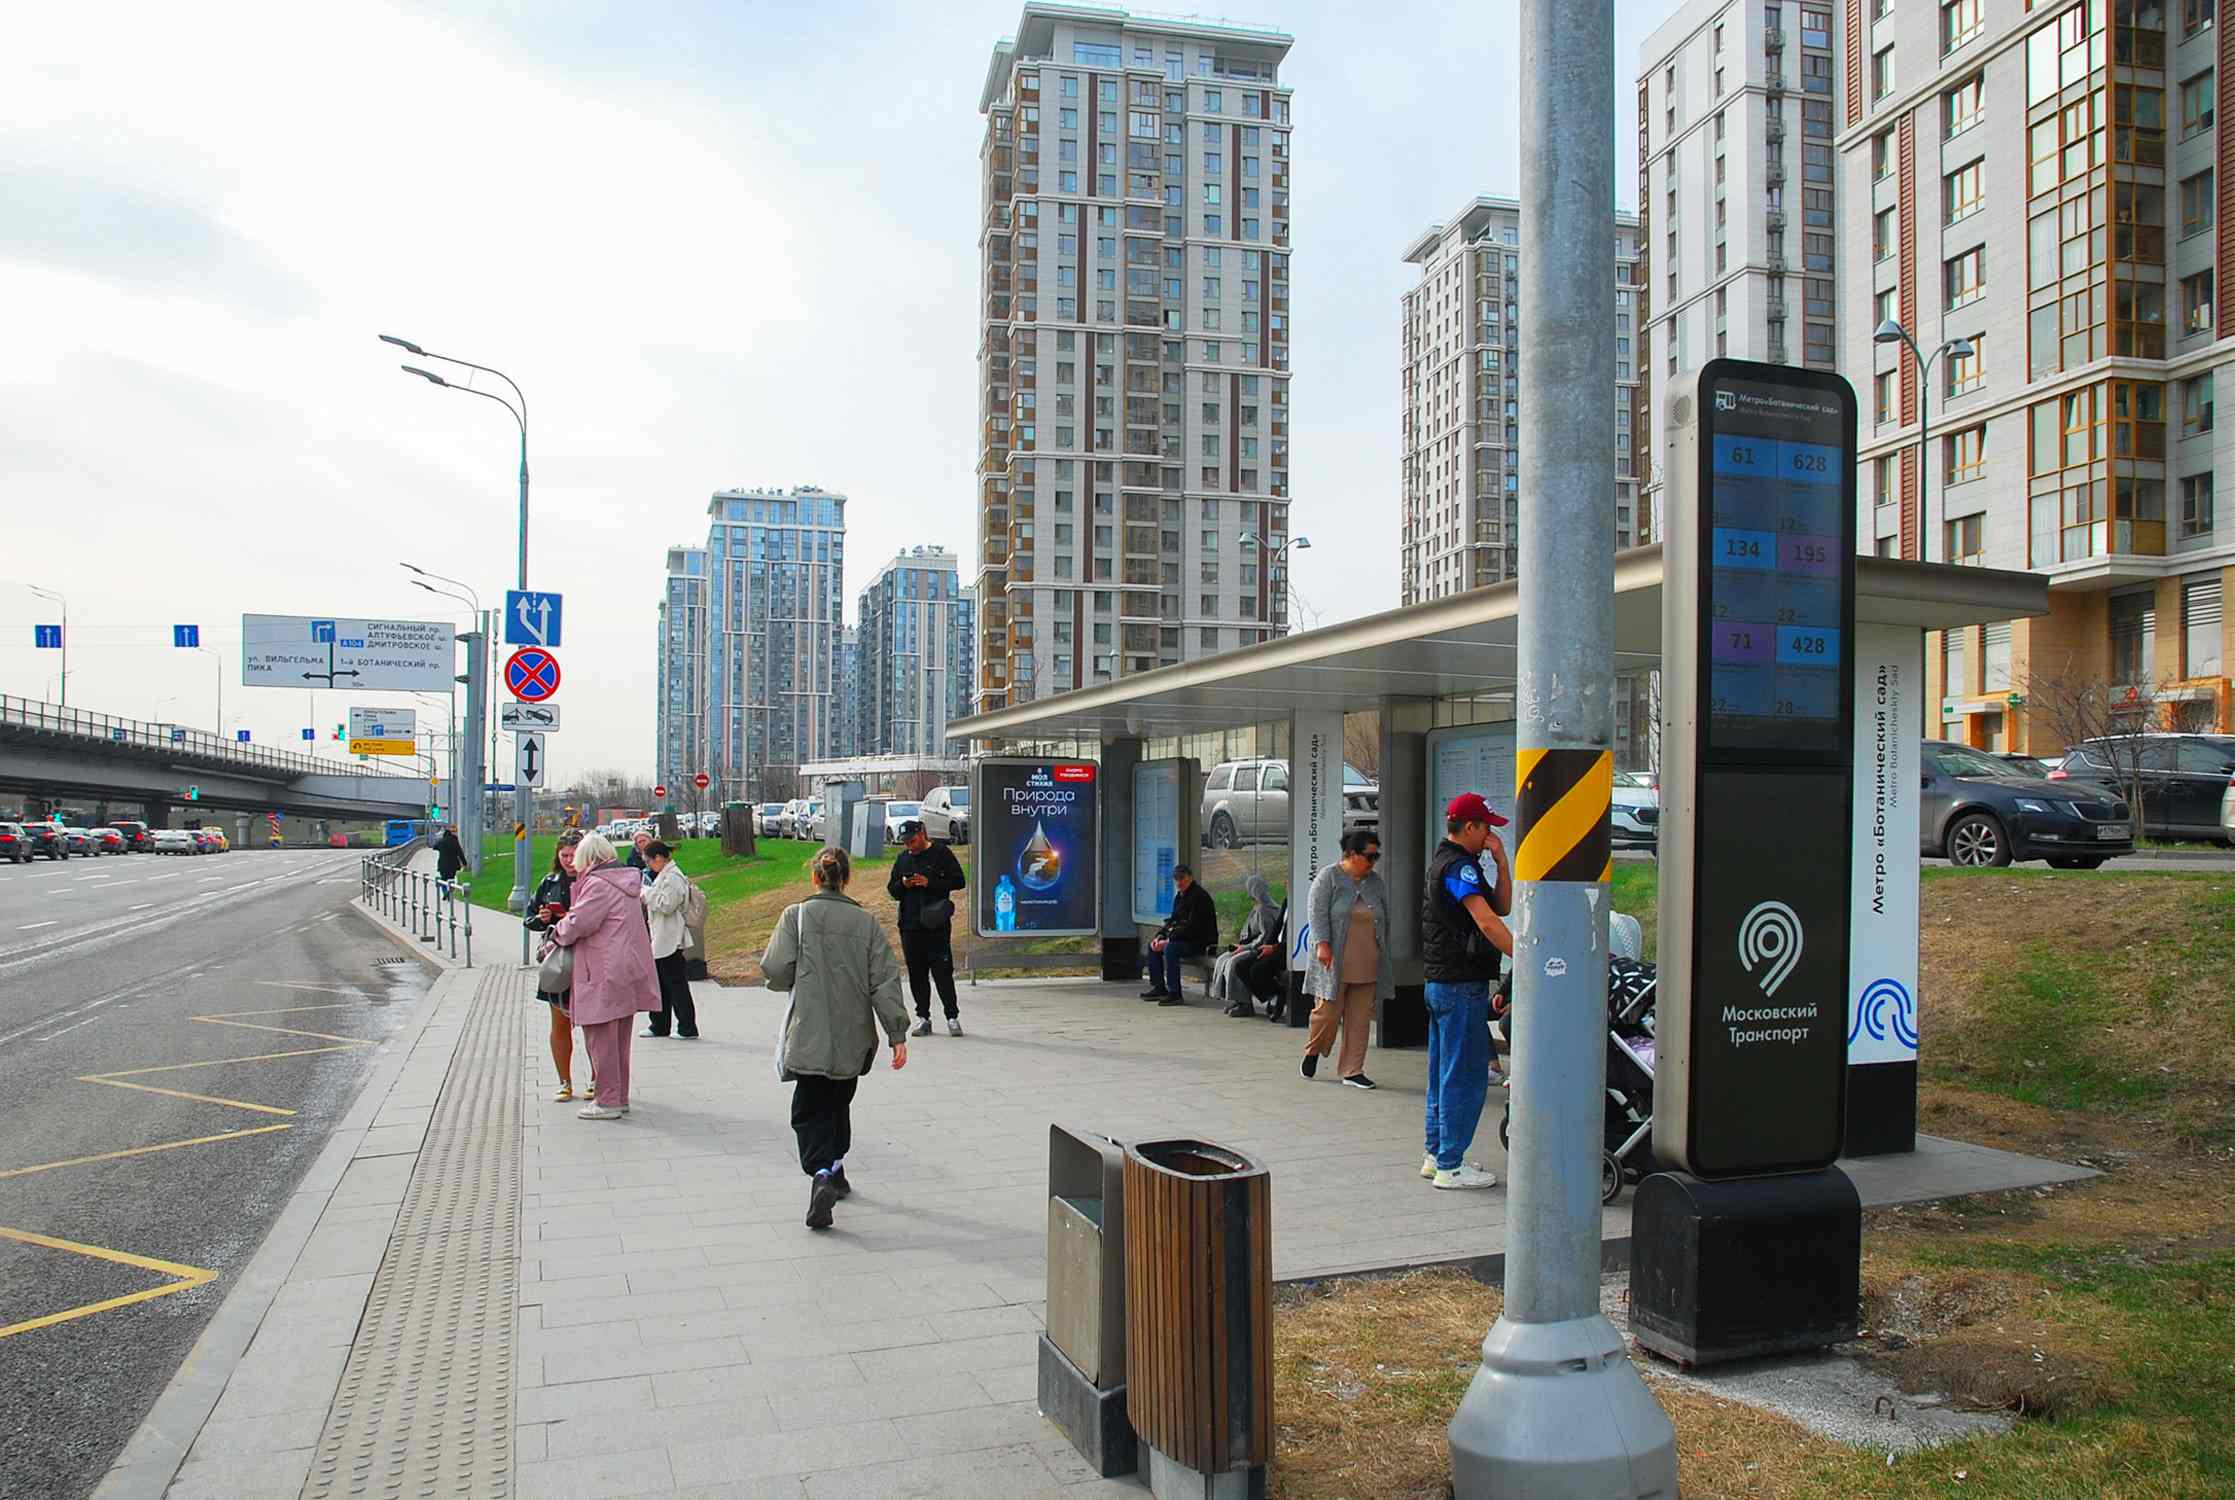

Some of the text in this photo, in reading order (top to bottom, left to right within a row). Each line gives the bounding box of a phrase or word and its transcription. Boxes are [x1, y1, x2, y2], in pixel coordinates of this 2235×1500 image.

[1732, 447, 1754, 464] 61
[1793, 454, 1827, 472] 628
[1727, 540, 1760, 558] 134
[1793, 545, 1826, 562] 195
[367, 623, 426, 632] СИГНАЛЬНЫЙ
[367, 640, 430, 650] ДМИТРОВСКОЕ
[1730, 633, 1752, 650] 71
[1792, 637, 1825, 654] 428
[247, 664, 272, 672] ПИКА
[265, 655, 324, 664] ВИЛЬГЕЛЬМА
[357, 658, 426, 668] БОТАНИЧЕСКИЙ
[1003, 788, 1075, 803] Природа
[1873, 665, 1888, 915] Метро «Ботанический сад»
[1889, 773, 1898, 808] Metro
[1011, 804, 1068, 817] внутри
[1309, 846, 1319, 881] Метро
[1722, 1002, 1818, 1022] Московский
[1729, 1027, 1809, 1048] Транспорт
